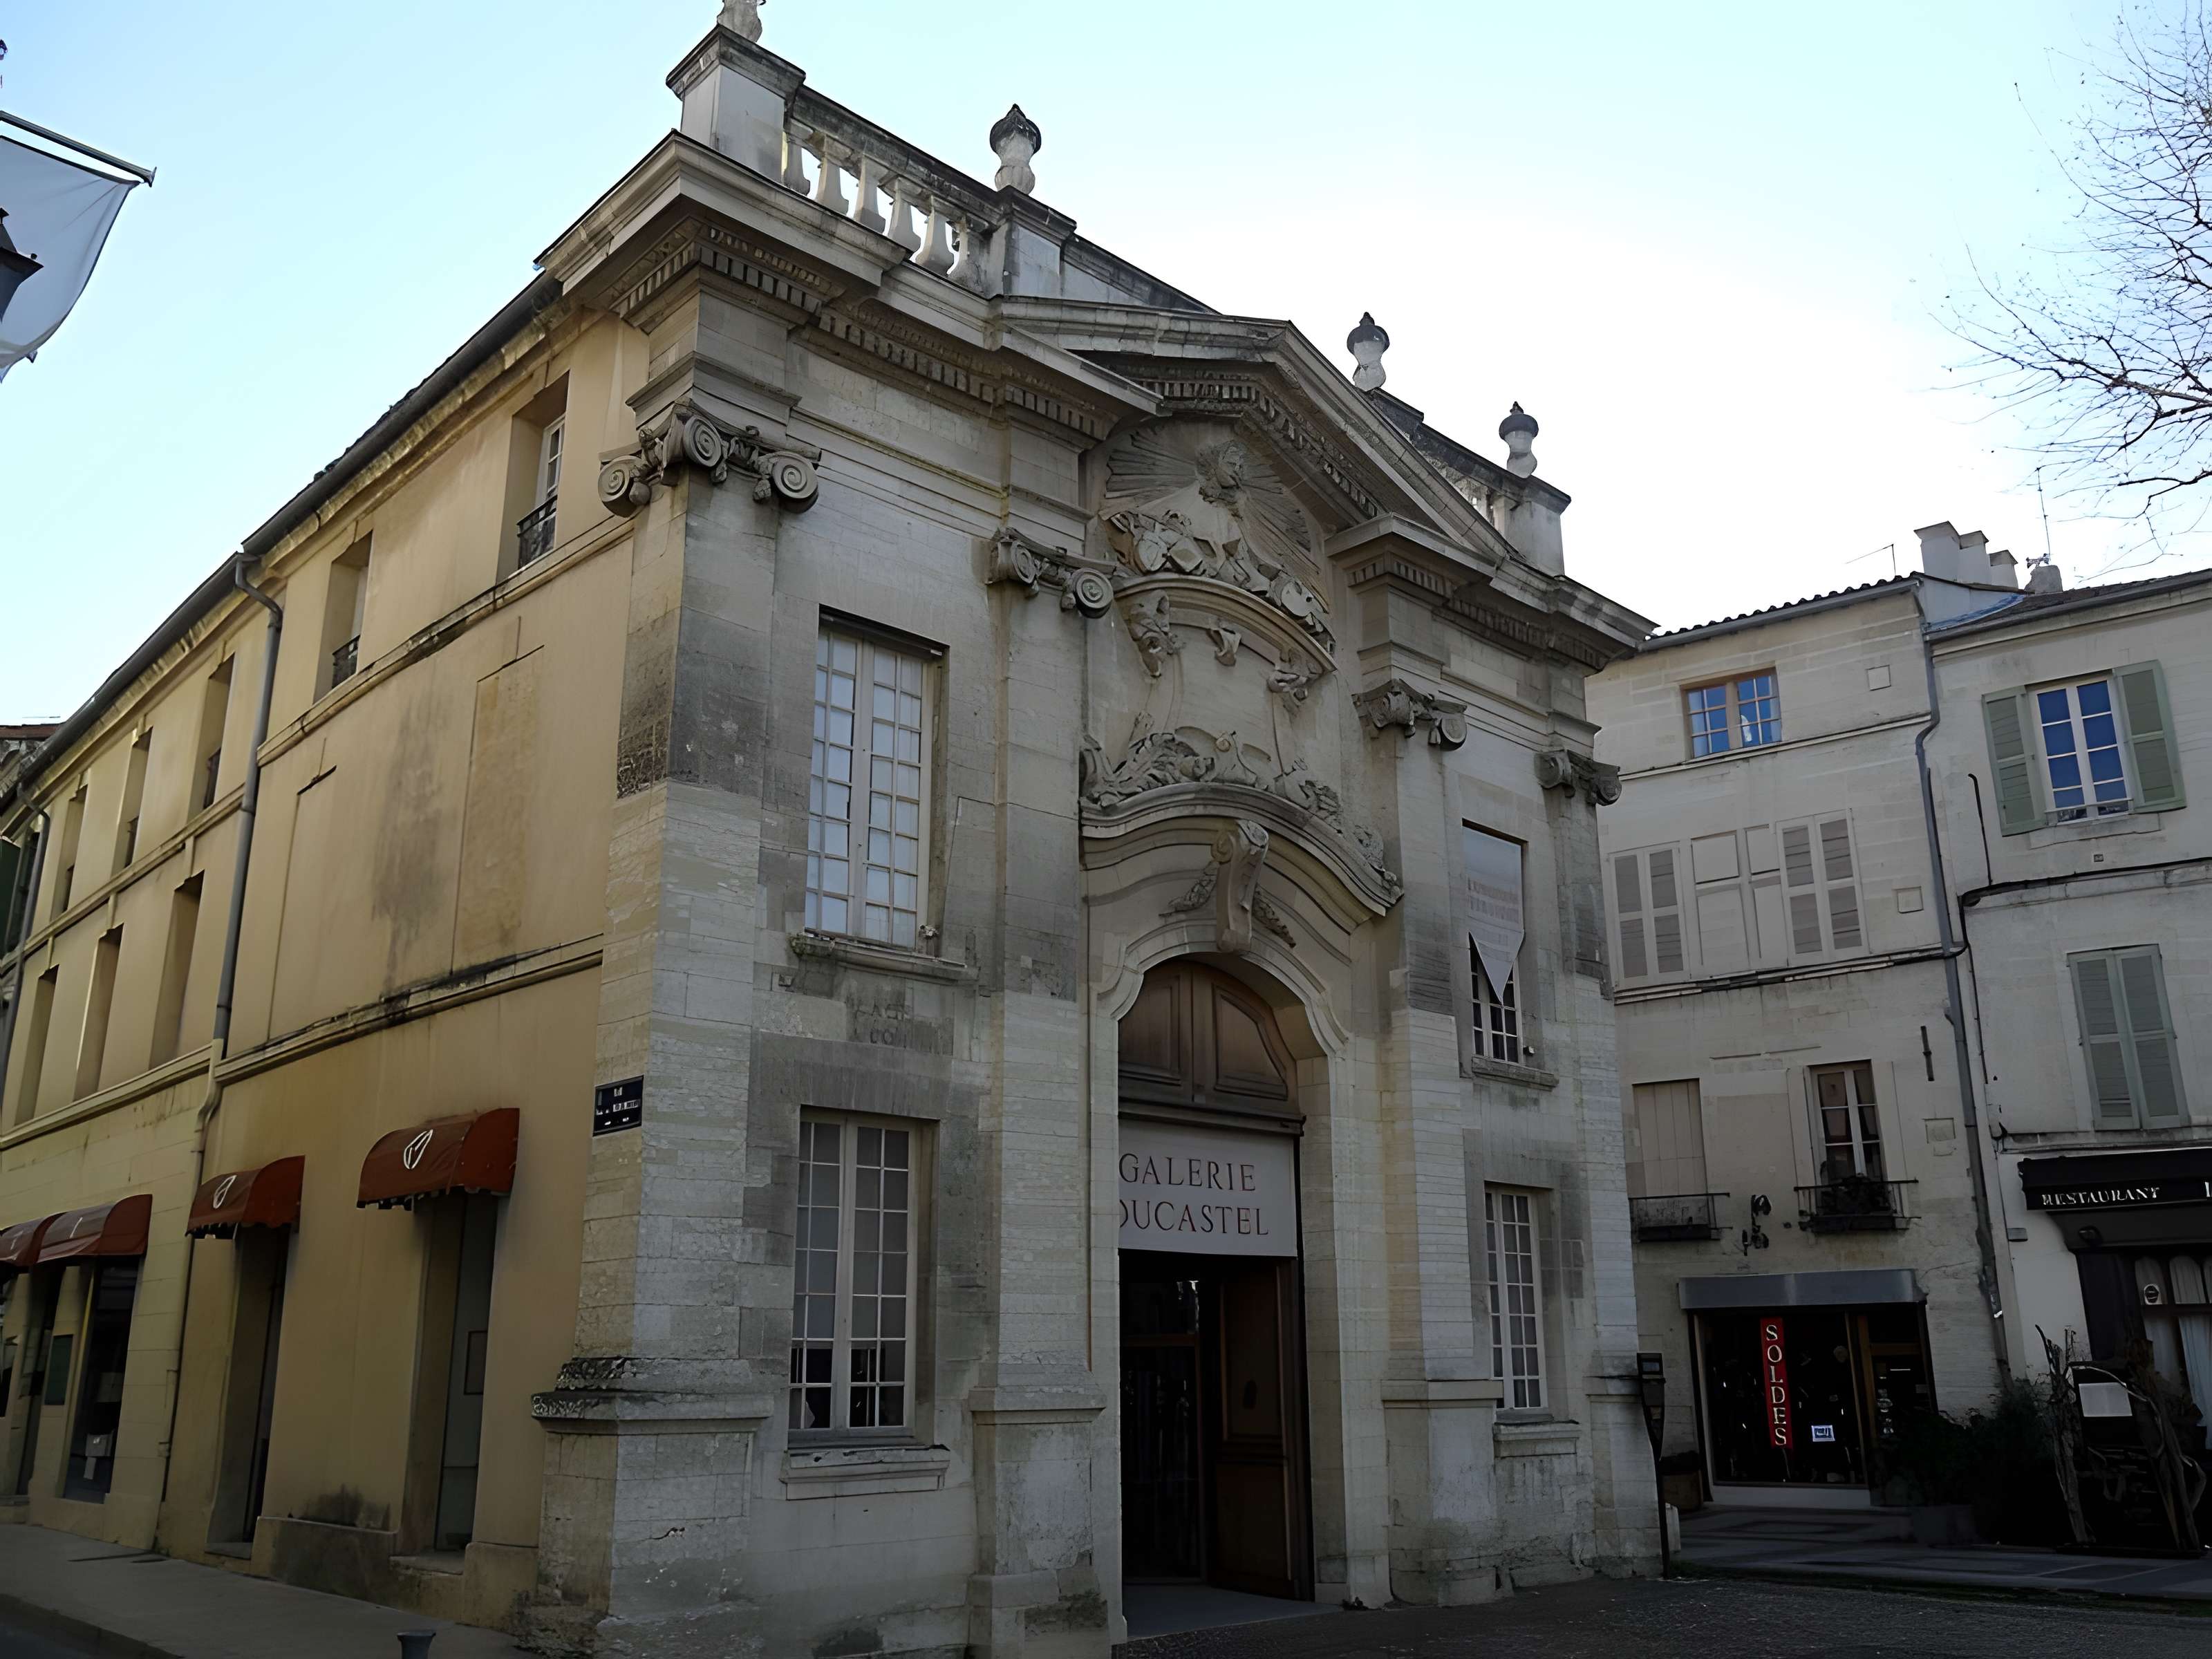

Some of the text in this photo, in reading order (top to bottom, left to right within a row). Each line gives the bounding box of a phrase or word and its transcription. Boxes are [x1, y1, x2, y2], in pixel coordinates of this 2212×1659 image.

[1118, 1153, 1256, 1192] GALERIE
[2041, 1186, 2160, 1206] RESTAURANT
[1765, 1324, 1788, 1447] SOLDES
